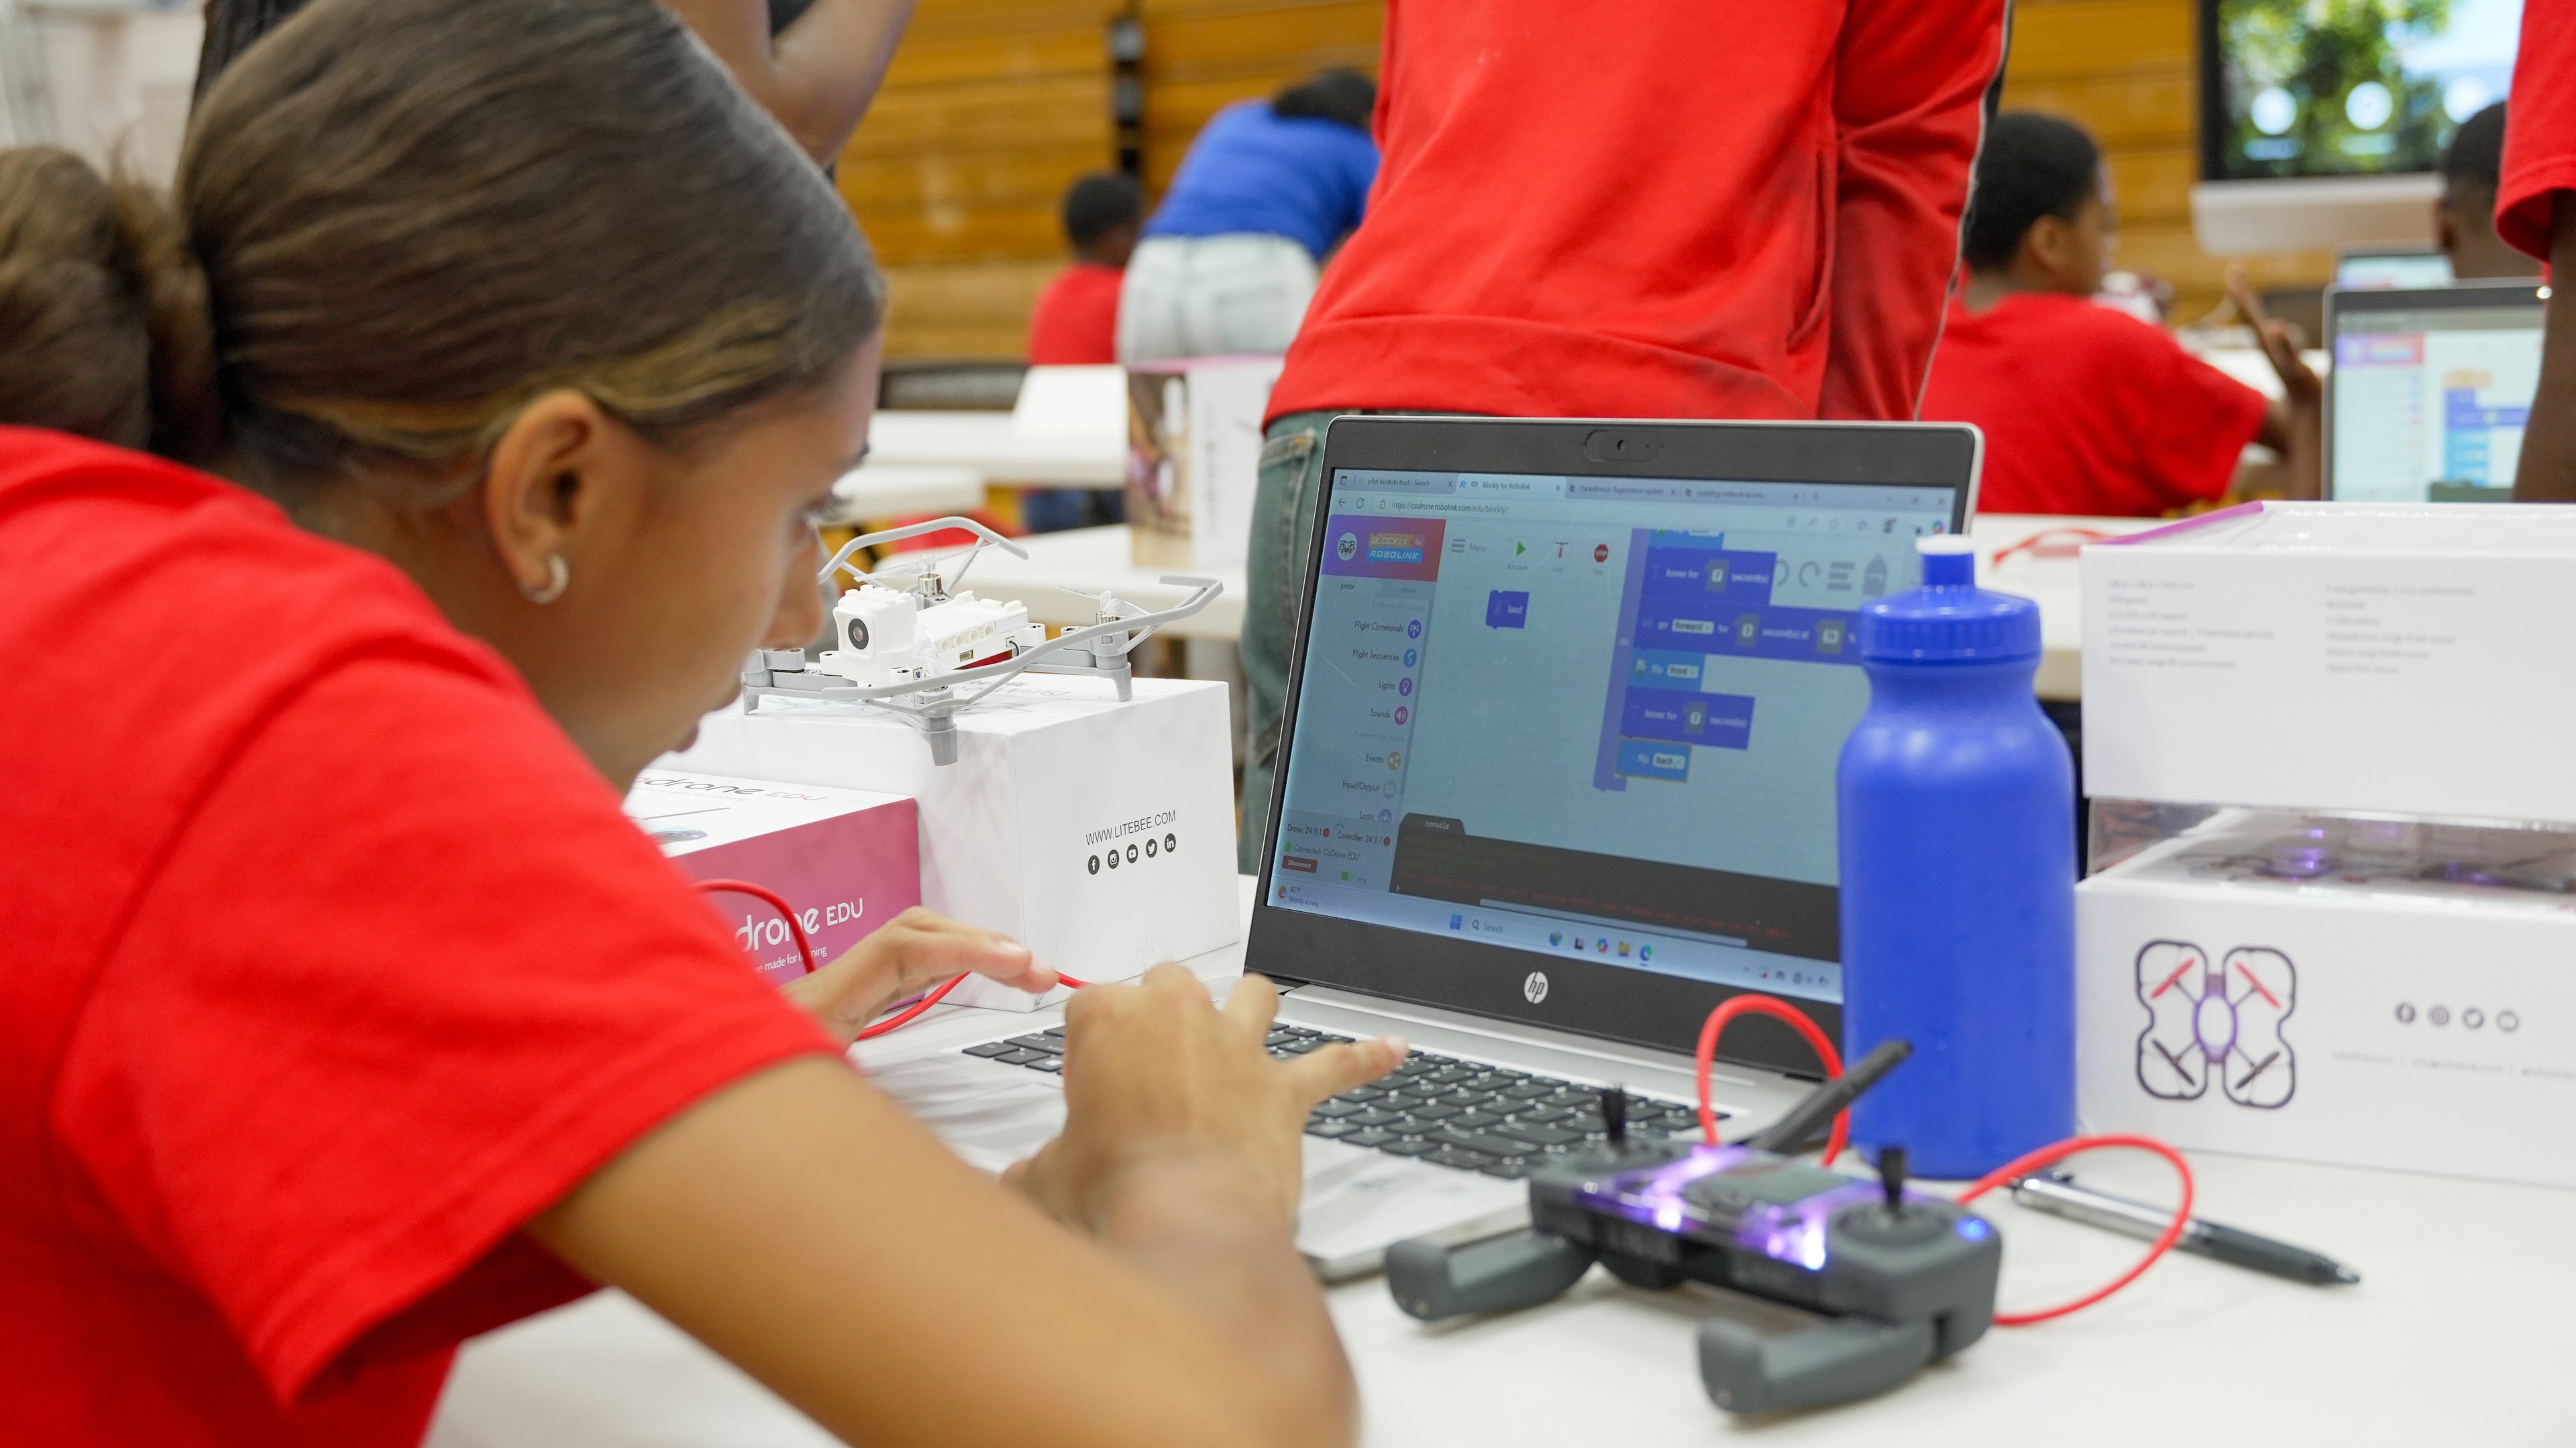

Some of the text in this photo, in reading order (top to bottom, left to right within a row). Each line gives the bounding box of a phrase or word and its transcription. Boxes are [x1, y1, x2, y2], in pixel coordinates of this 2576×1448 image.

[1482, 481, 1499, 490] Blockly
[1371, 536, 1408, 546] BLOCKLY
[1370, 550, 1419, 560] ROBOLINK
[1507, 605, 1523, 614] land
[1354, 621, 1404, 633] Flight Commands
[1352, 650, 1399, 661] Flight Sequences
[1379, 680, 1395, 690] Lights
[1370, 709, 1391, 718] Sounds
[1365, 754, 1383, 764] Events
[1342, 780, 1379, 792] Input/Output
[766, 792, 827, 800] EDU
[1359, 811, 1374, 822] Logic
[1085, 810, 1176, 845] WWW.LITEBEE.COM
[1287, 824, 1322, 836] Drone: 24.9.1
[1426, 821, 1450, 830] console
[1337, 831, 1363, 842] Controller:
[1323, 847, 1346, 858] CoDrone
[1288, 860, 1311, 869] Disconnect
[1289, 896, 1320, 907] Mostly sunny
[826, 898, 863, 926] EDU
[765, 957, 786, 971] made
[787, 954, 797, 964] for
[798, 947, 827, 961] lning
[1525, 972, 1547, 1003] hp
